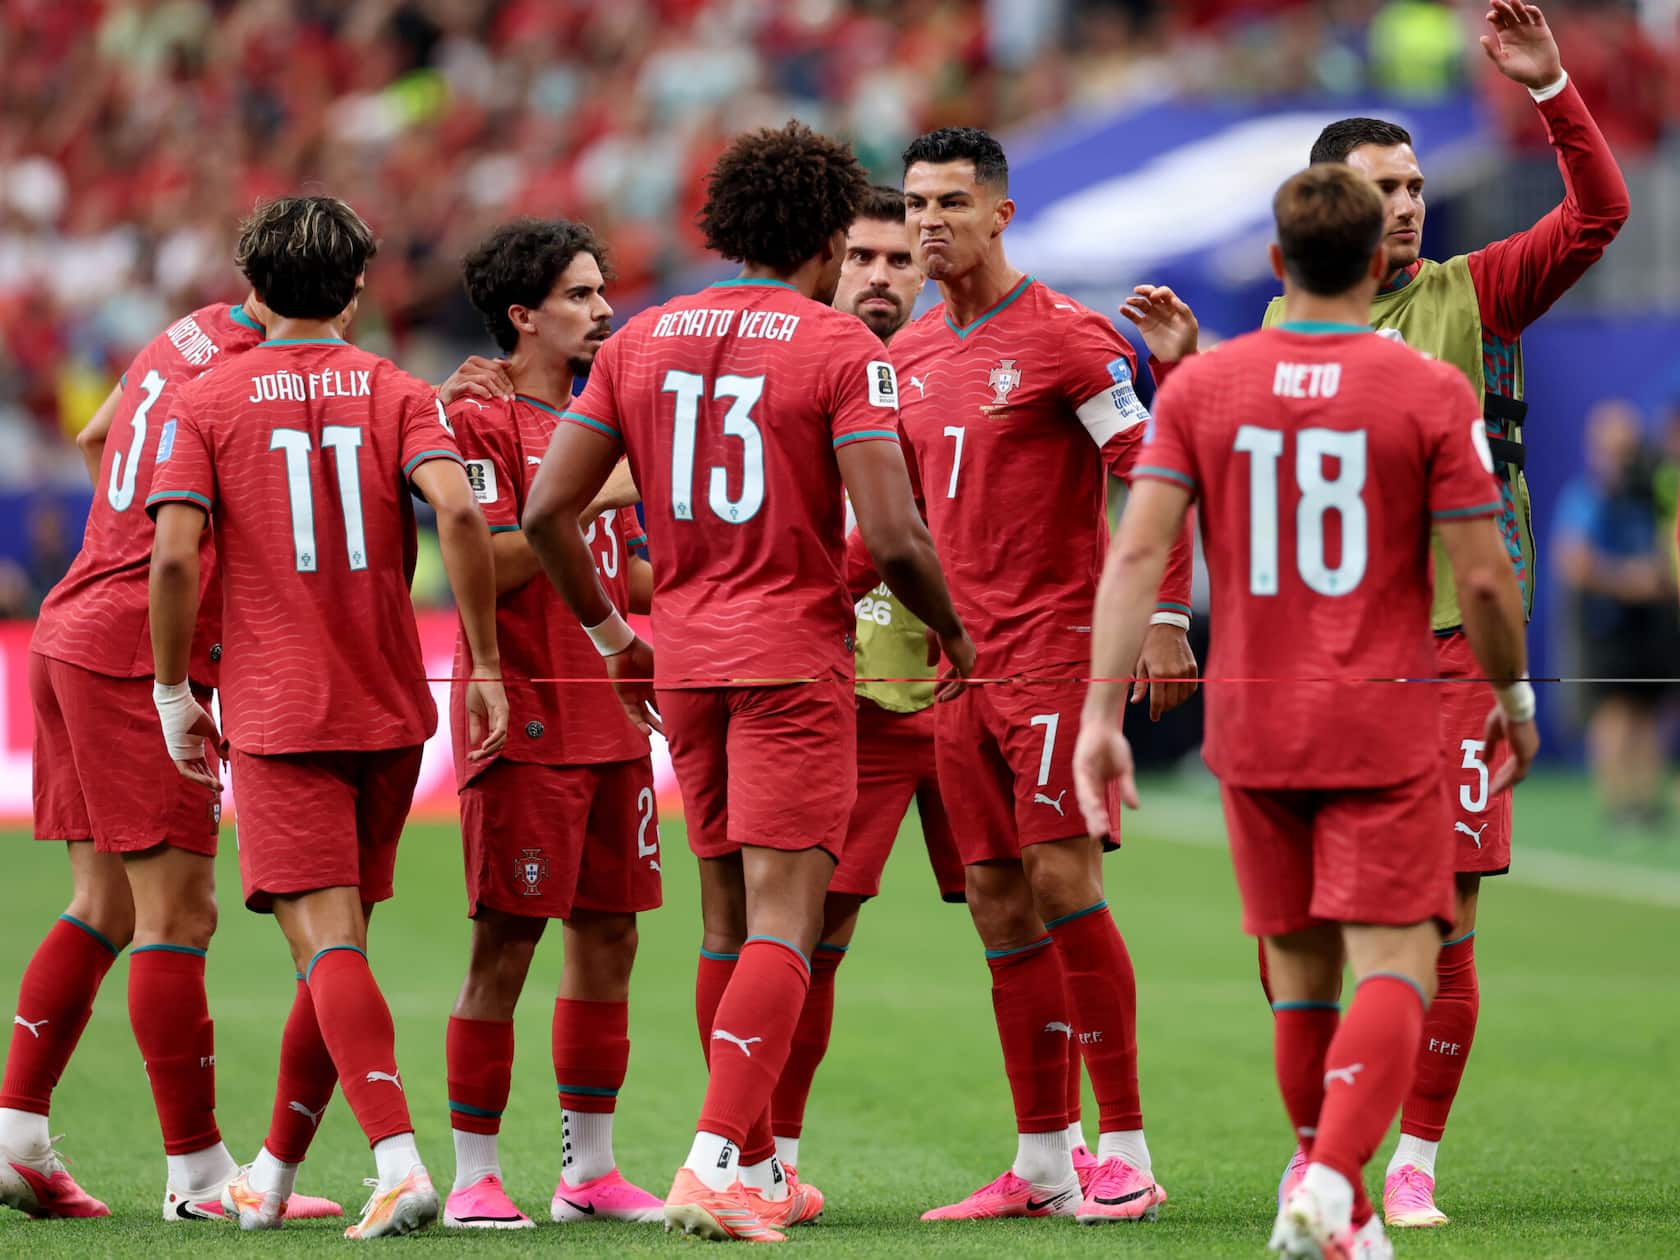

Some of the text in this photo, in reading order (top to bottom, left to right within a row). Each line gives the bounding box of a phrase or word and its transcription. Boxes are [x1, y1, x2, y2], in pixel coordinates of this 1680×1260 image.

[652, 309, 800, 342] RENATO VEIGA
[249, 368, 371, 403] JOÃO FÉLIX
[1273, 361, 1343, 398] NETO
[108, 369, 167, 512] 3
[662, 370, 766, 524] 13
[943, 426, 965, 498] 7
[269, 425, 368, 572] 11
[1233, 425, 1367, 597] 18
[1030, 712, 1060, 786] 7
[1460, 739, 1489, 812] 5
[637, 787, 661, 859] 2
